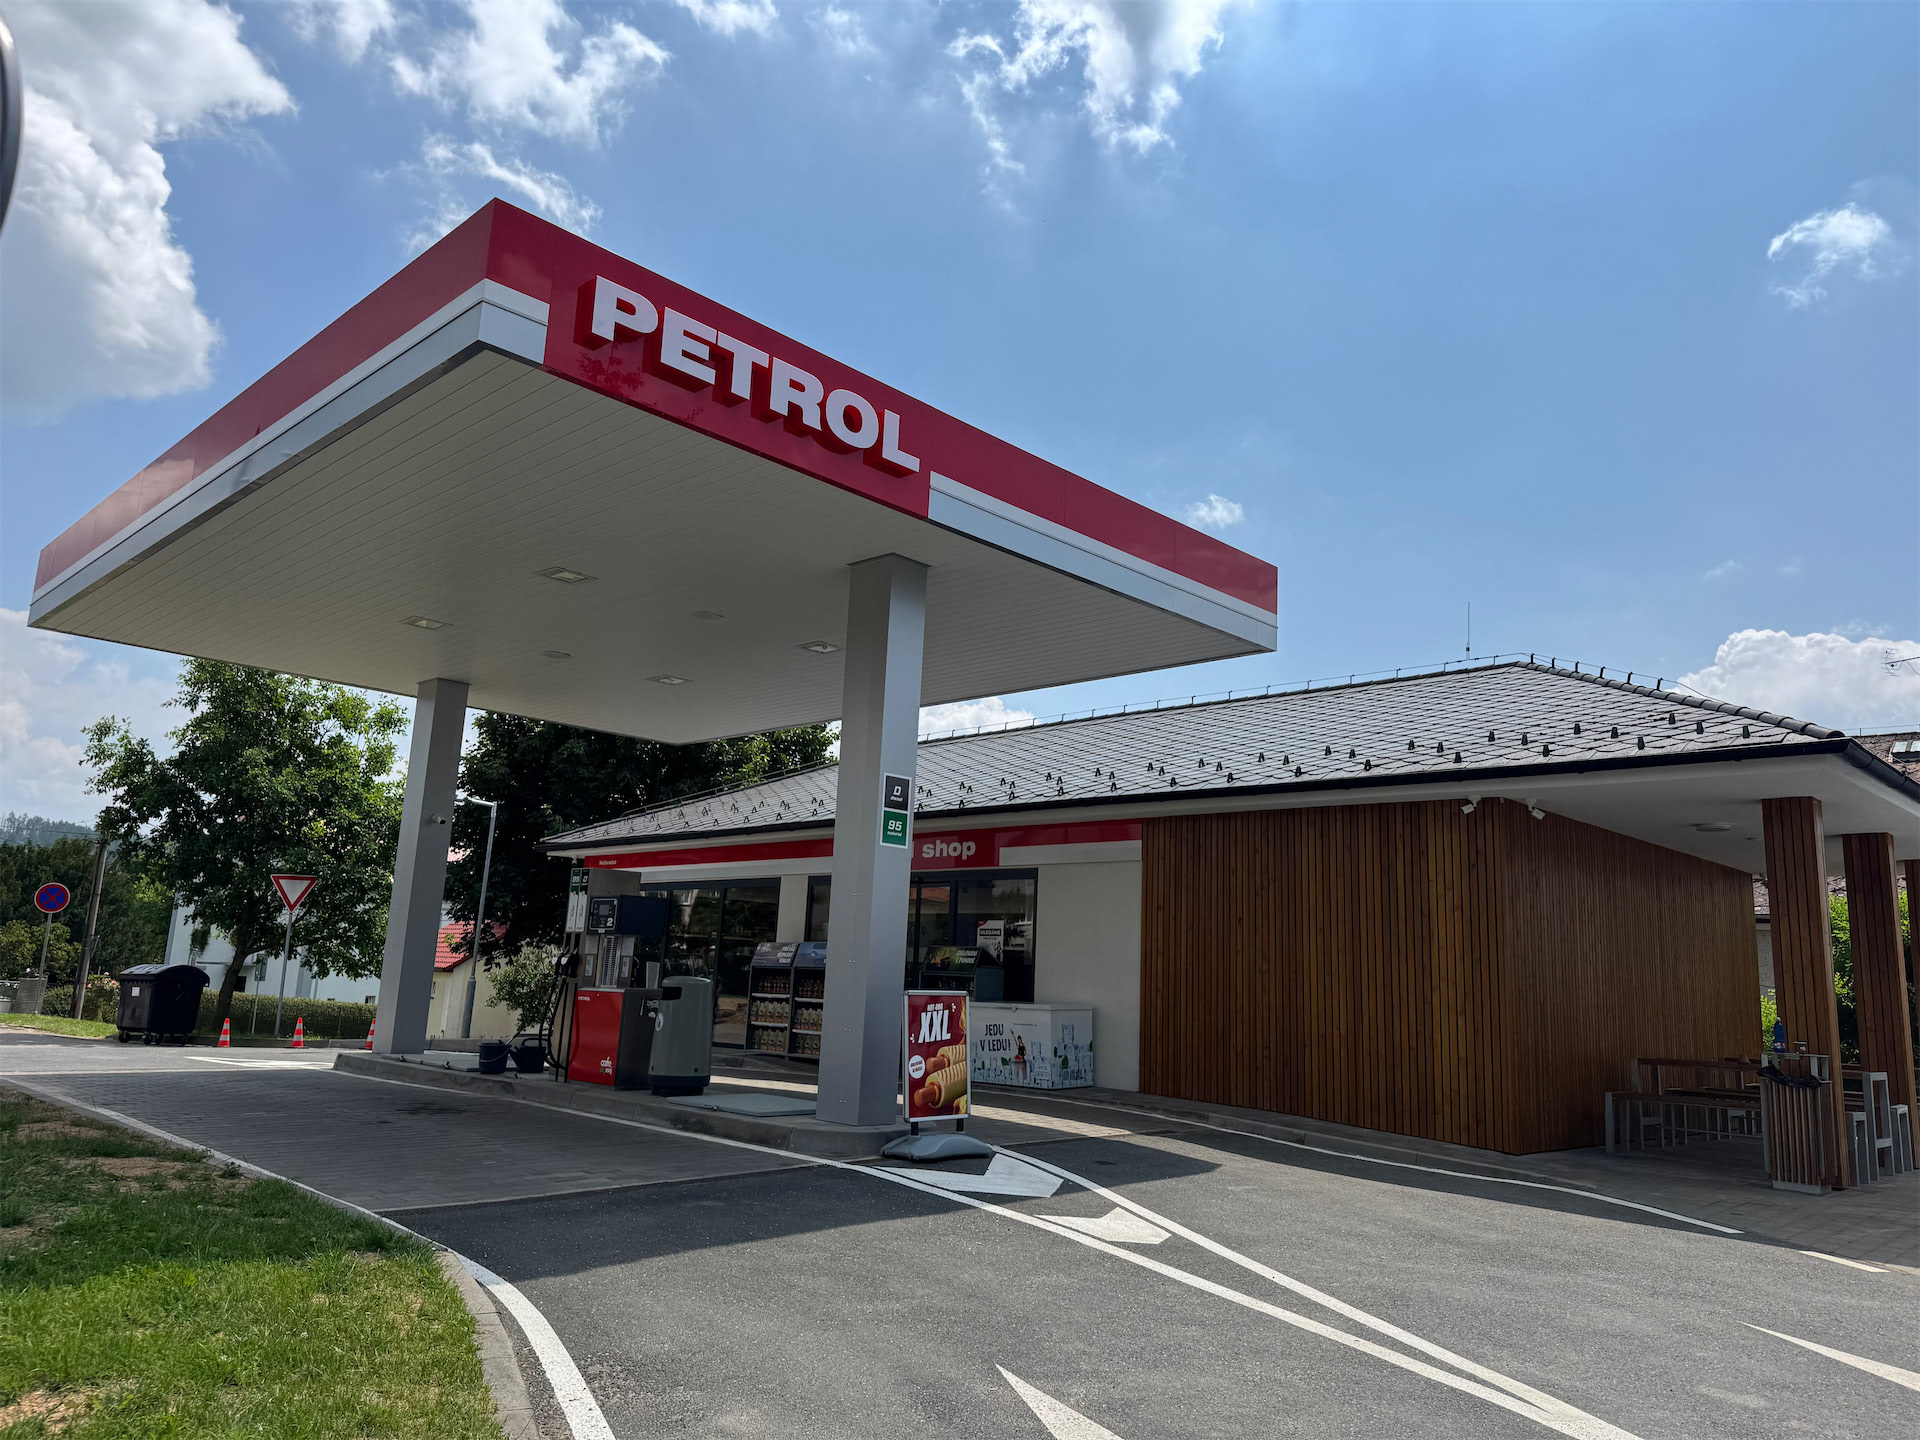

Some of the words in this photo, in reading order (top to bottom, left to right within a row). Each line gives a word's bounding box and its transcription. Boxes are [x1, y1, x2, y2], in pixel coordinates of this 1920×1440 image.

[591, 275, 920, 473] PETROL
[893, 786, 901, 795] D
[888, 820, 903, 831] 95
[922, 840, 976, 860] shop
[607, 918, 613, 926] 2
[918, 1009, 951, 1043] XXL
[985, 1023, 1004, 1036] JEDU
[980, 1039, 985, 1052] V
[988, 1038, 1011, 1052] LEDU!
